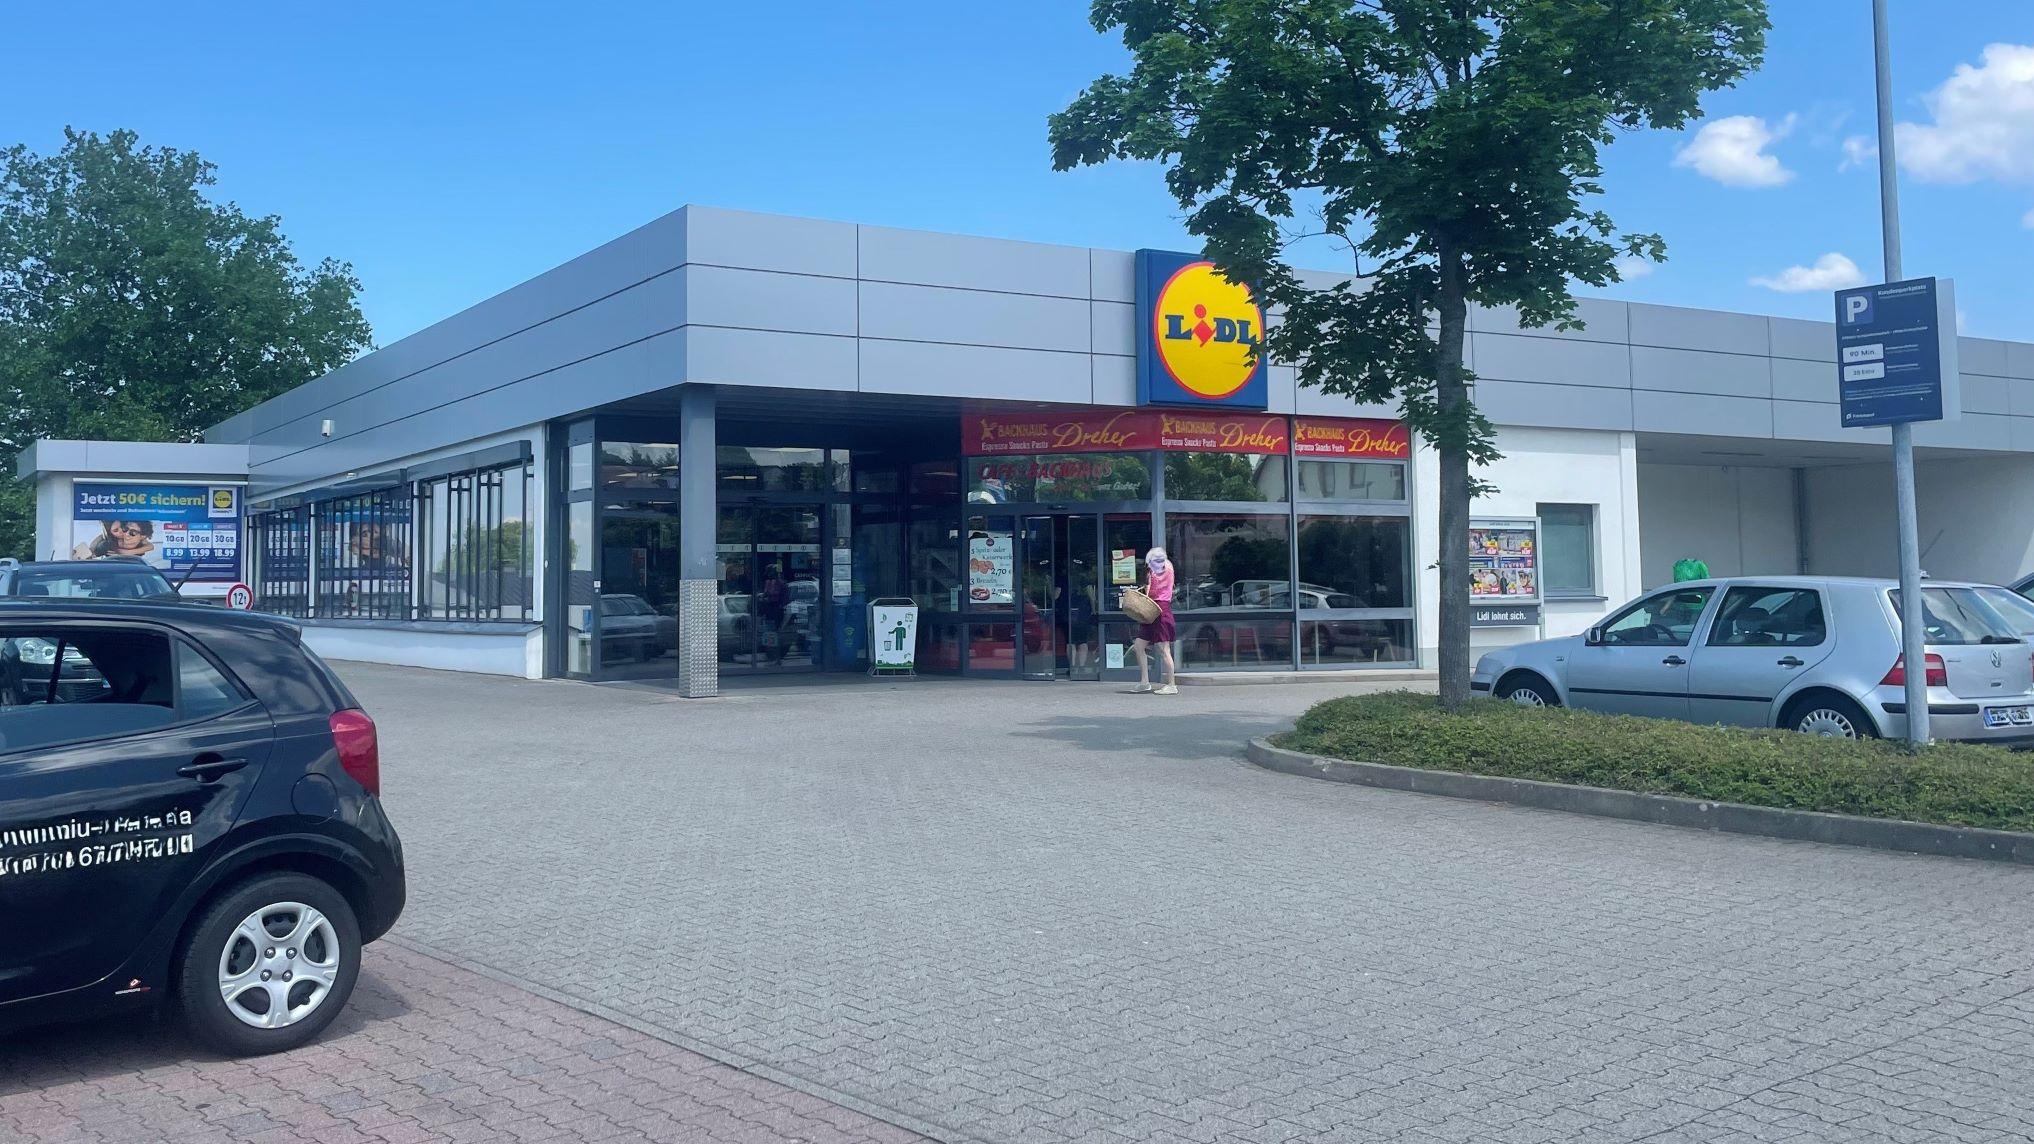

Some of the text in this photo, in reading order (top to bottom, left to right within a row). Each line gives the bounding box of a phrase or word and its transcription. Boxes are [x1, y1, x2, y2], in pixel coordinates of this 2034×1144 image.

[1846, 296, 1868, 323] P
[1052, 412, 1137, 448] Dreher
[1220, 417, 1283, 450] Dreher
[1348, 423, 1407, 455] Dreher
[81, 493, 206, 506] Jetzt 50€ sichern!
[165, 535, 175, 543] 10
[189, 535, 200, 543] 20
[166, 548, 235, 557] 8.99 13.99 18.99
[990, 568, 1007, 577] 2,70
[1476, 611, 1527, 621] Lidl lohnt sich.
